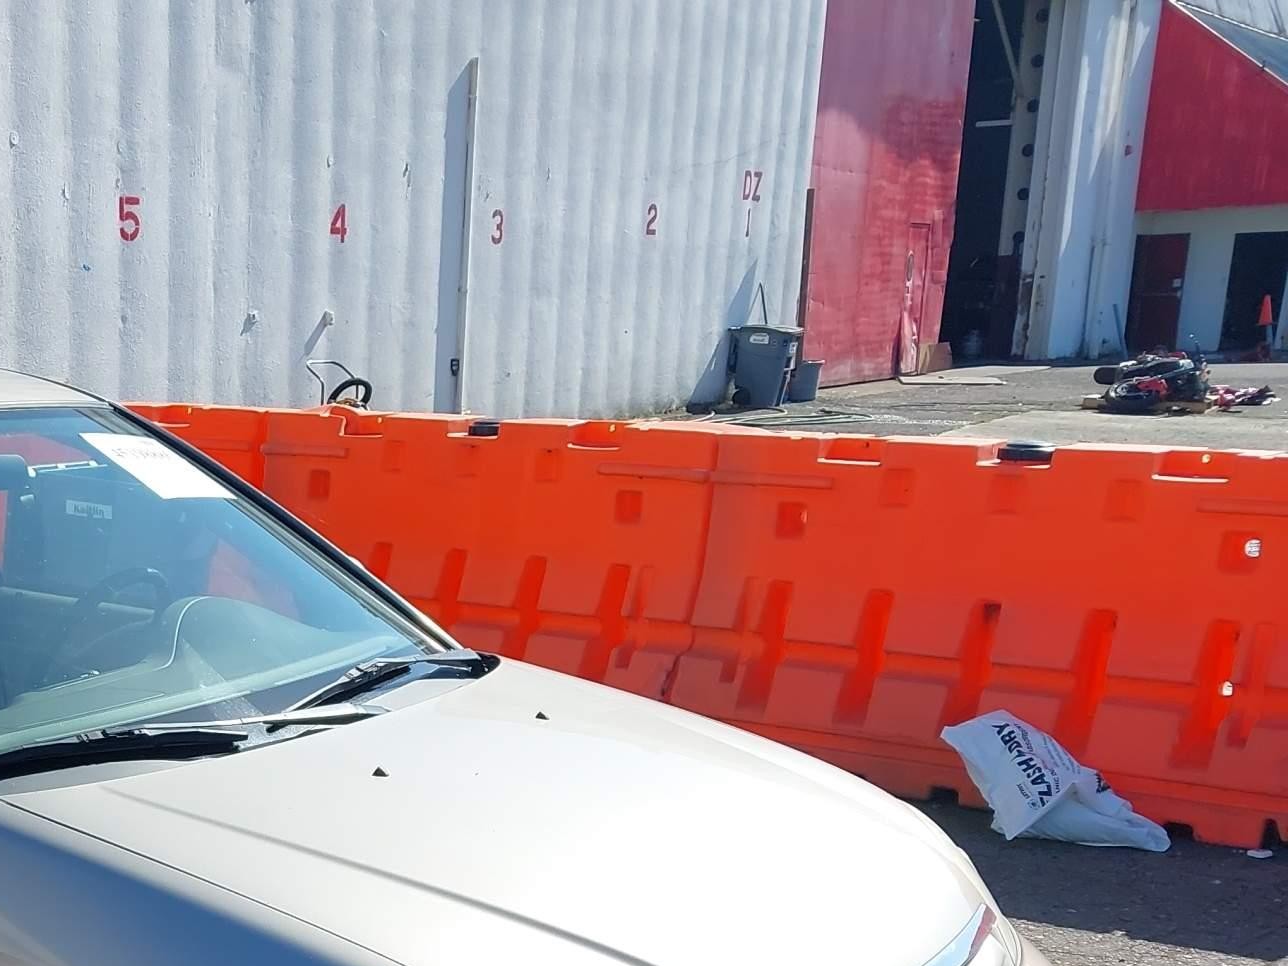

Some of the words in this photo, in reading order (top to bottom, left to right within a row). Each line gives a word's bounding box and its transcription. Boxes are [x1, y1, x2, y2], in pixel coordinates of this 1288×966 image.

[743, 169, 763, 203] DZ
[119, 196, 141, 241] 5
[330, 204, 348, 243] 4
[491, 208, 504, 245] 3
[645, 203, 658, 236] 2
